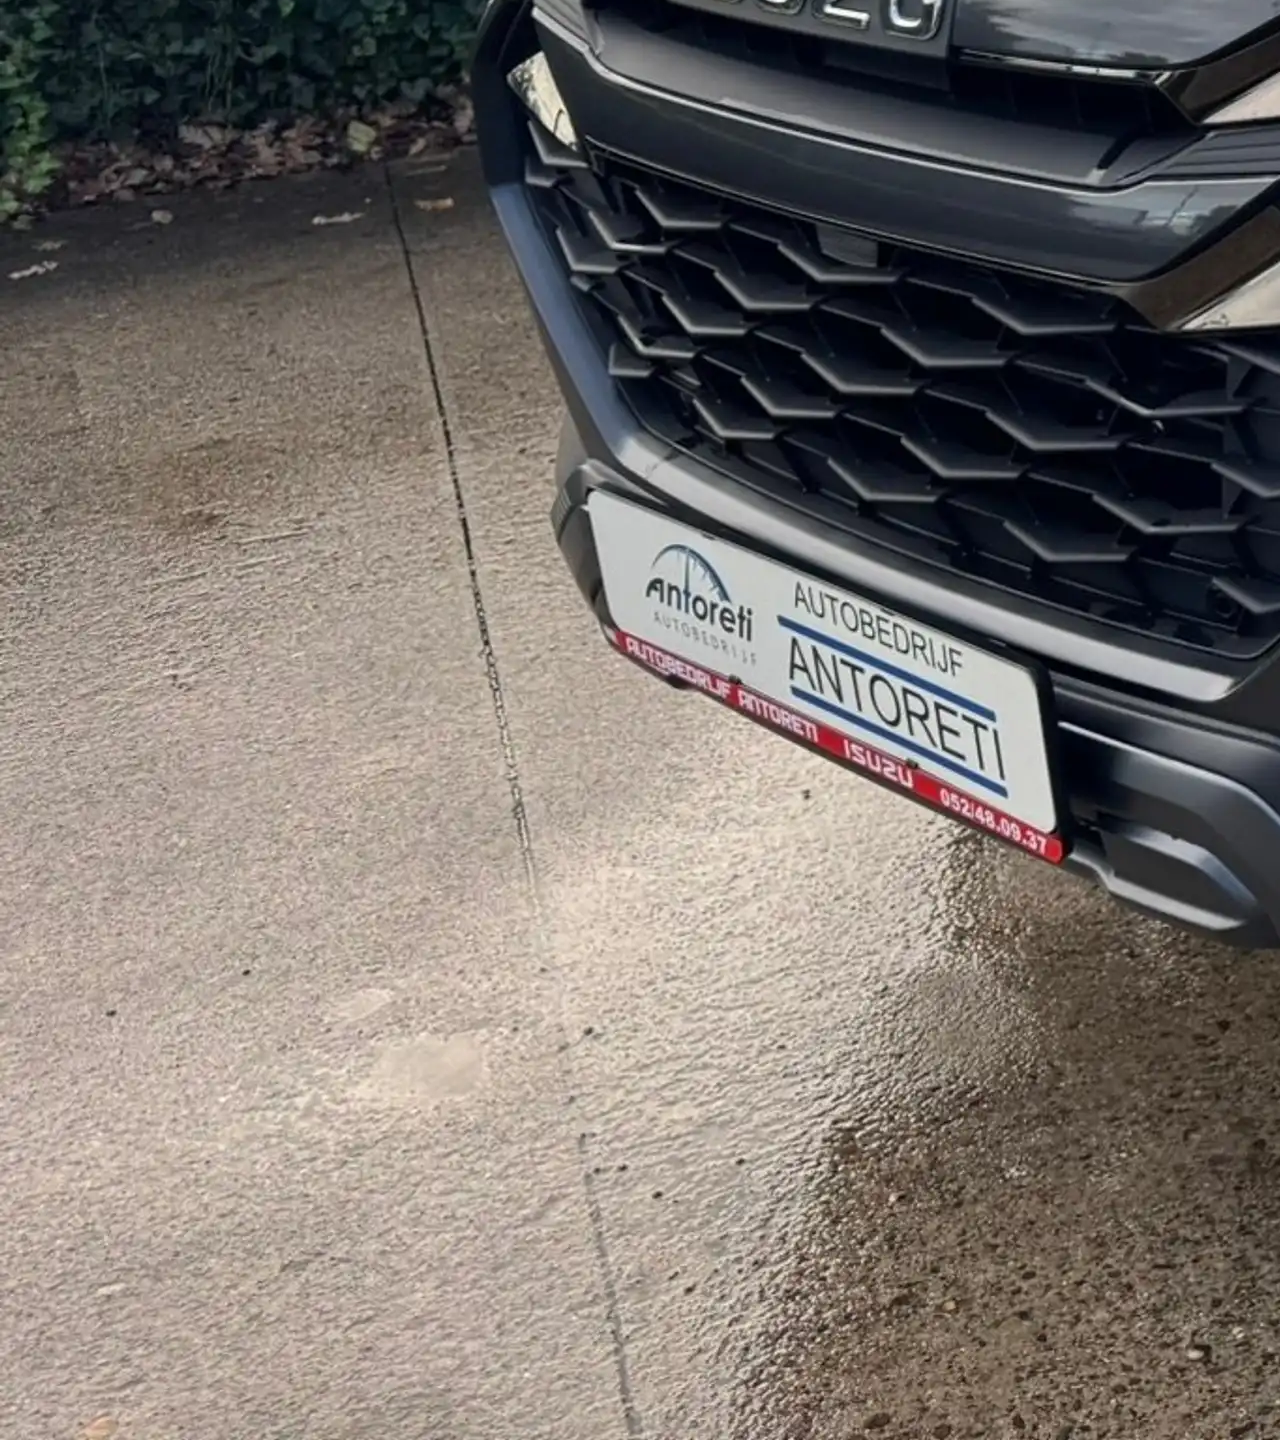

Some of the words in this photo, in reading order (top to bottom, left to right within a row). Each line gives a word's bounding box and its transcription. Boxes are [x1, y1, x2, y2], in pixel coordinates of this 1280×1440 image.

[646, 576, 753, 642] Antoreti
[653, 610, 757, 666] AUTOBEDRIJF
[793, 580, 963, 678] AUTOBEDRIJF
[625, 635, 732, 703] AUTOBEDRIJF
[736, 688, 820, 743] ANTORETI
[843, 739, 914, 790] ISUZU
[788, 636, 1006, 781] ANTORETI
